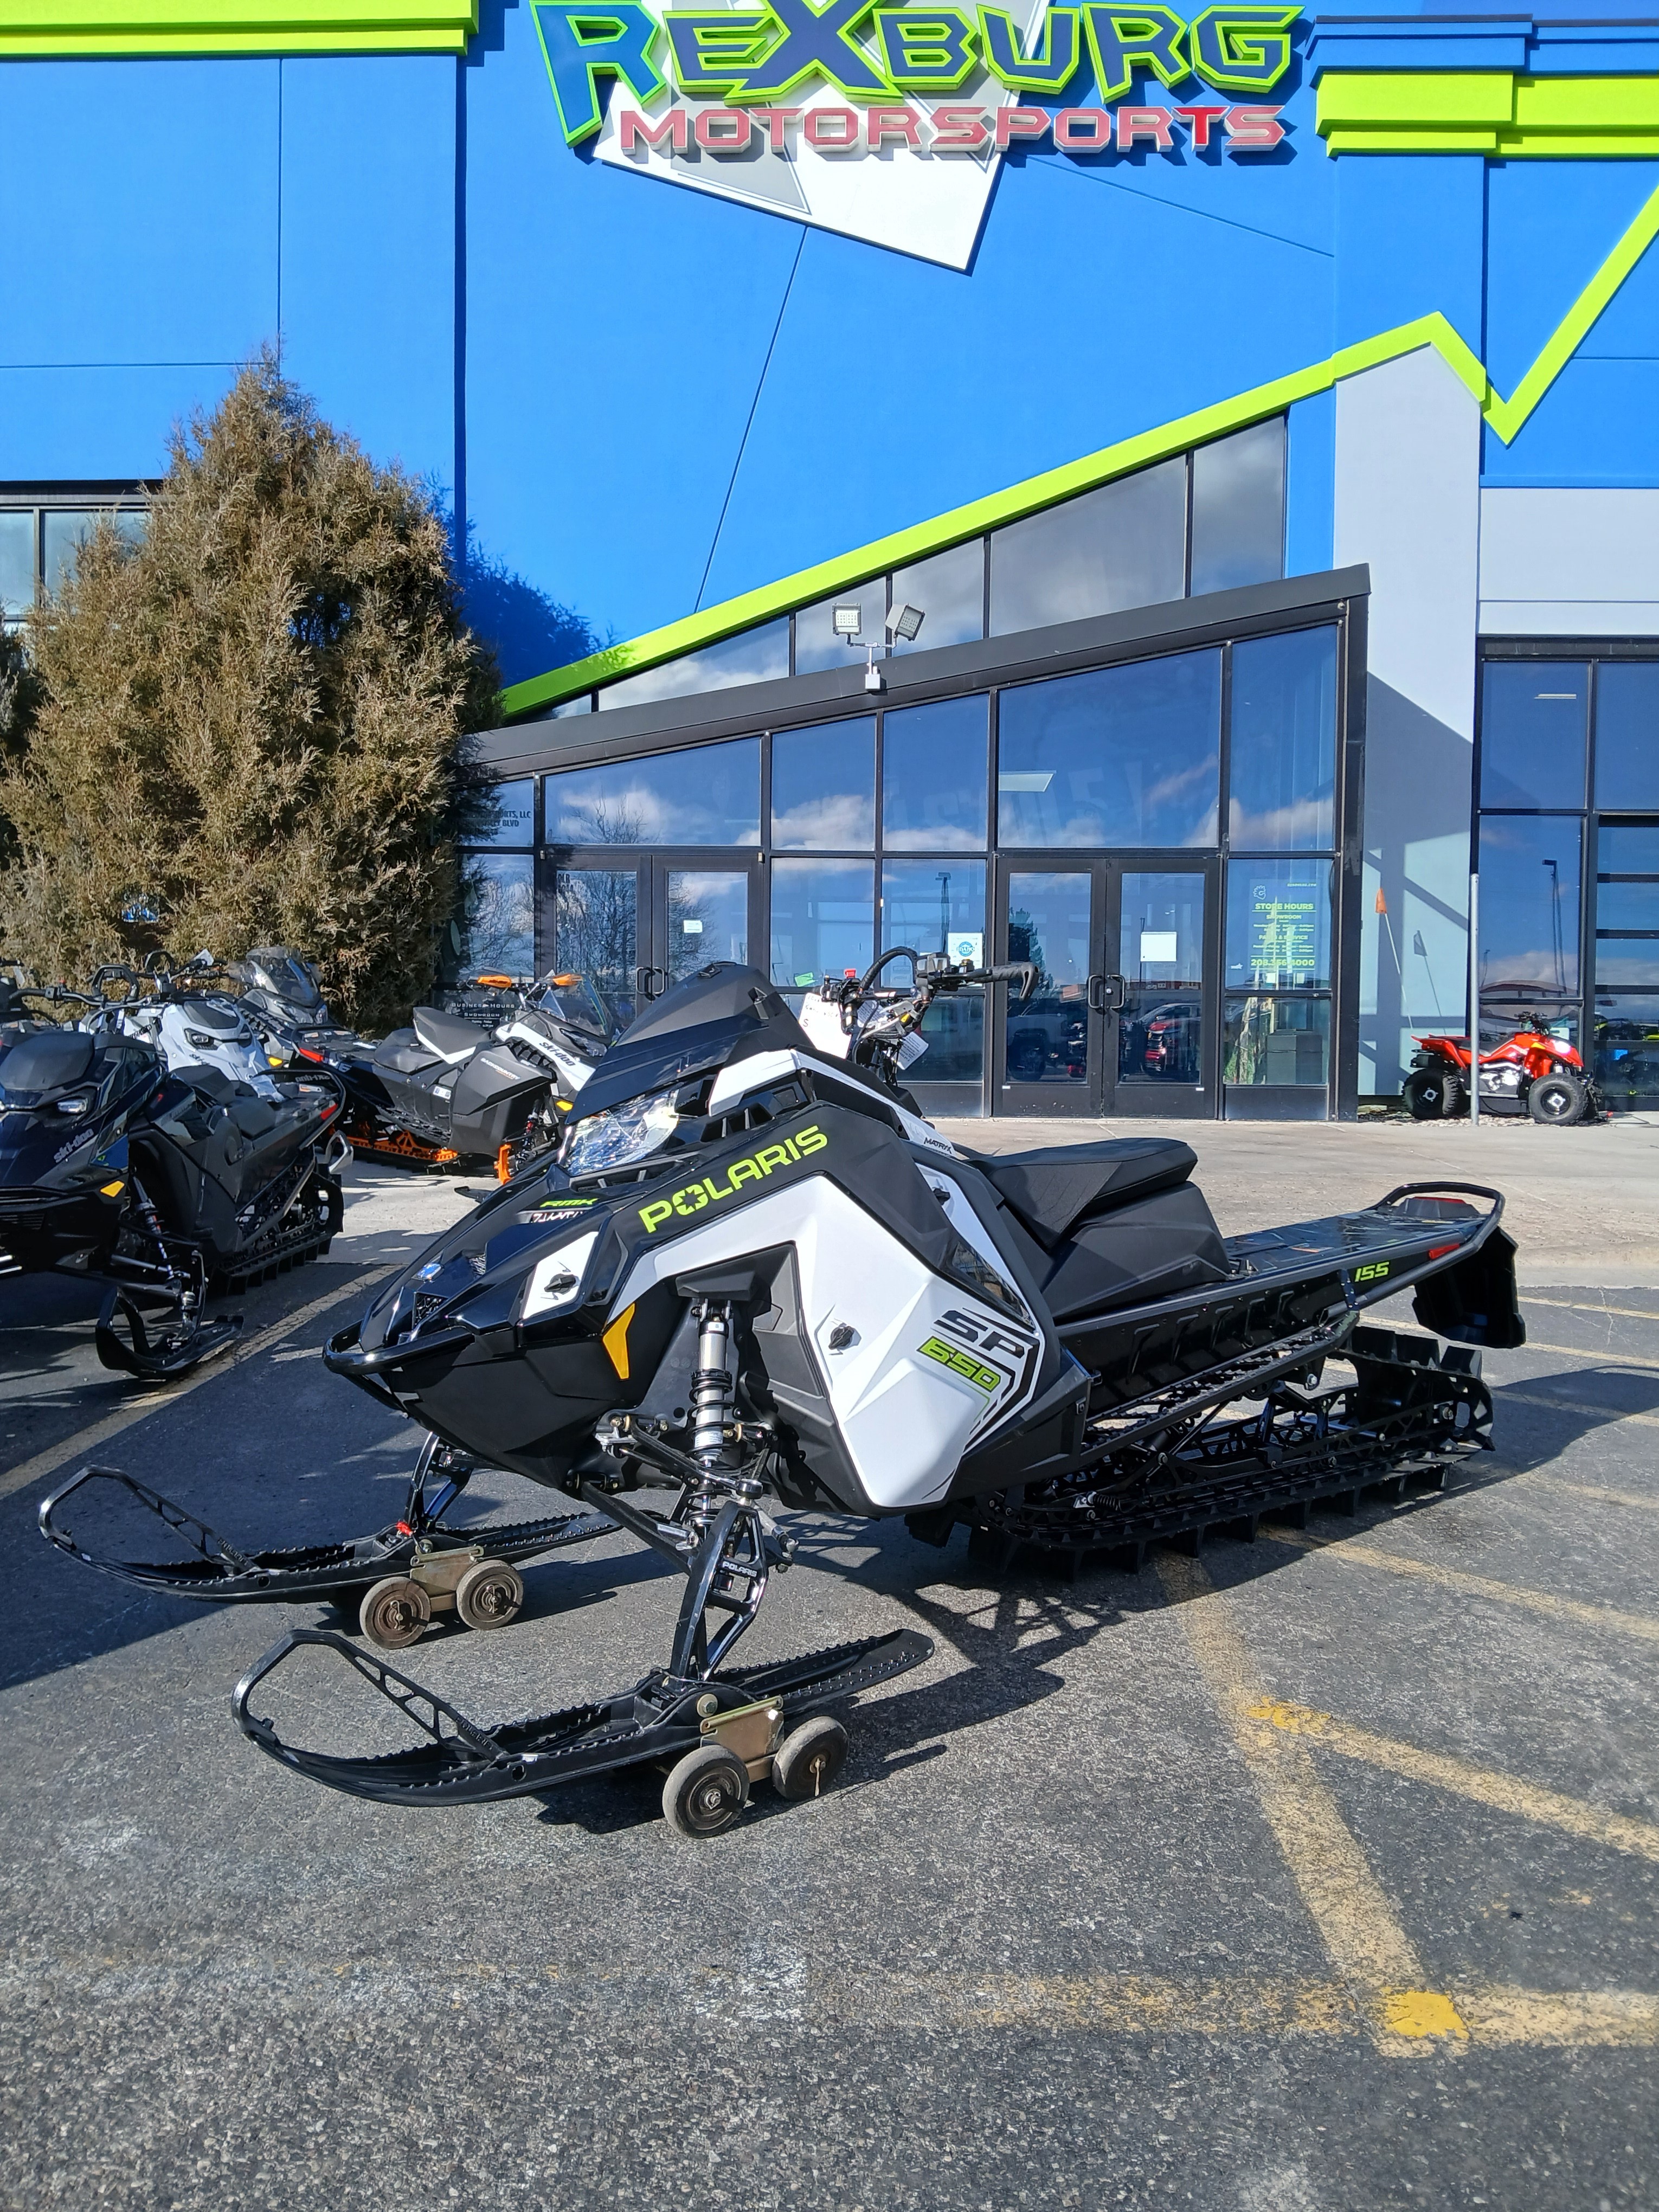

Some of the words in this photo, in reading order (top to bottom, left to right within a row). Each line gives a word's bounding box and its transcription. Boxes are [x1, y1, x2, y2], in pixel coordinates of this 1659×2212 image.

[530, 0, 1306, 147] REXBURG
[620, 105, 1287, 154] MOTORSPORTS
[539, 1041, 576, 1066] ski-doo
[480, 1058, 521, 1081] BACKCOUNTRY
[54, 1128, 94, 1163] ski-doo
[923, 1137, 952, 1154] MATRYX
[638, 1125, 828, 1233] POLARIS
[539, 1198, 600, 1208] RMK
[1354, 1261, 1390, 1283] 155
[933, 1310, 1025, 1359] SP
[916, 1335, 1001, 1393] 650
[722, 1560, 757, 1578] POLARIS
